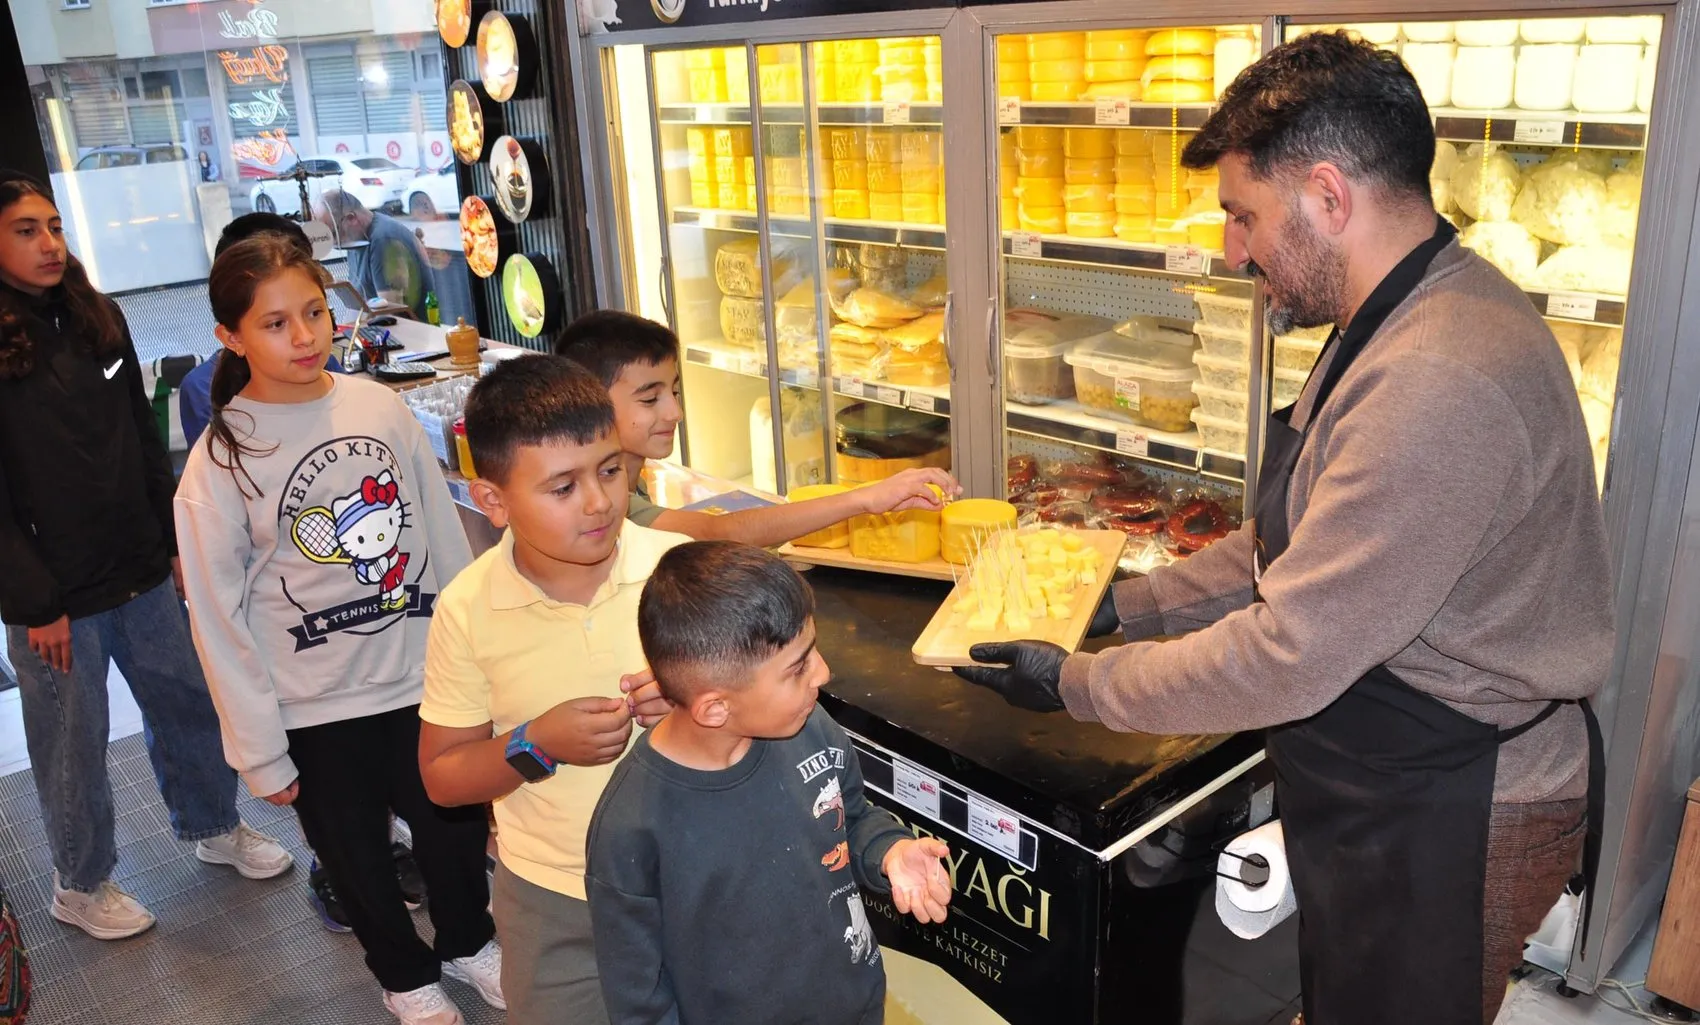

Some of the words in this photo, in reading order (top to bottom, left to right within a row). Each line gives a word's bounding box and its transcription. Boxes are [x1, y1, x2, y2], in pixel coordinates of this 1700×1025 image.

[283, 448, 338, 520] HELLO
[345, 441, 396, 472] KITT
[330, 602, 379, 624] TENNIS
[799, 754, 829, 781] DINO
[935, 934, 1003, 984] KATKISIZ
[953, 926, 1009, 968] LEZZET
